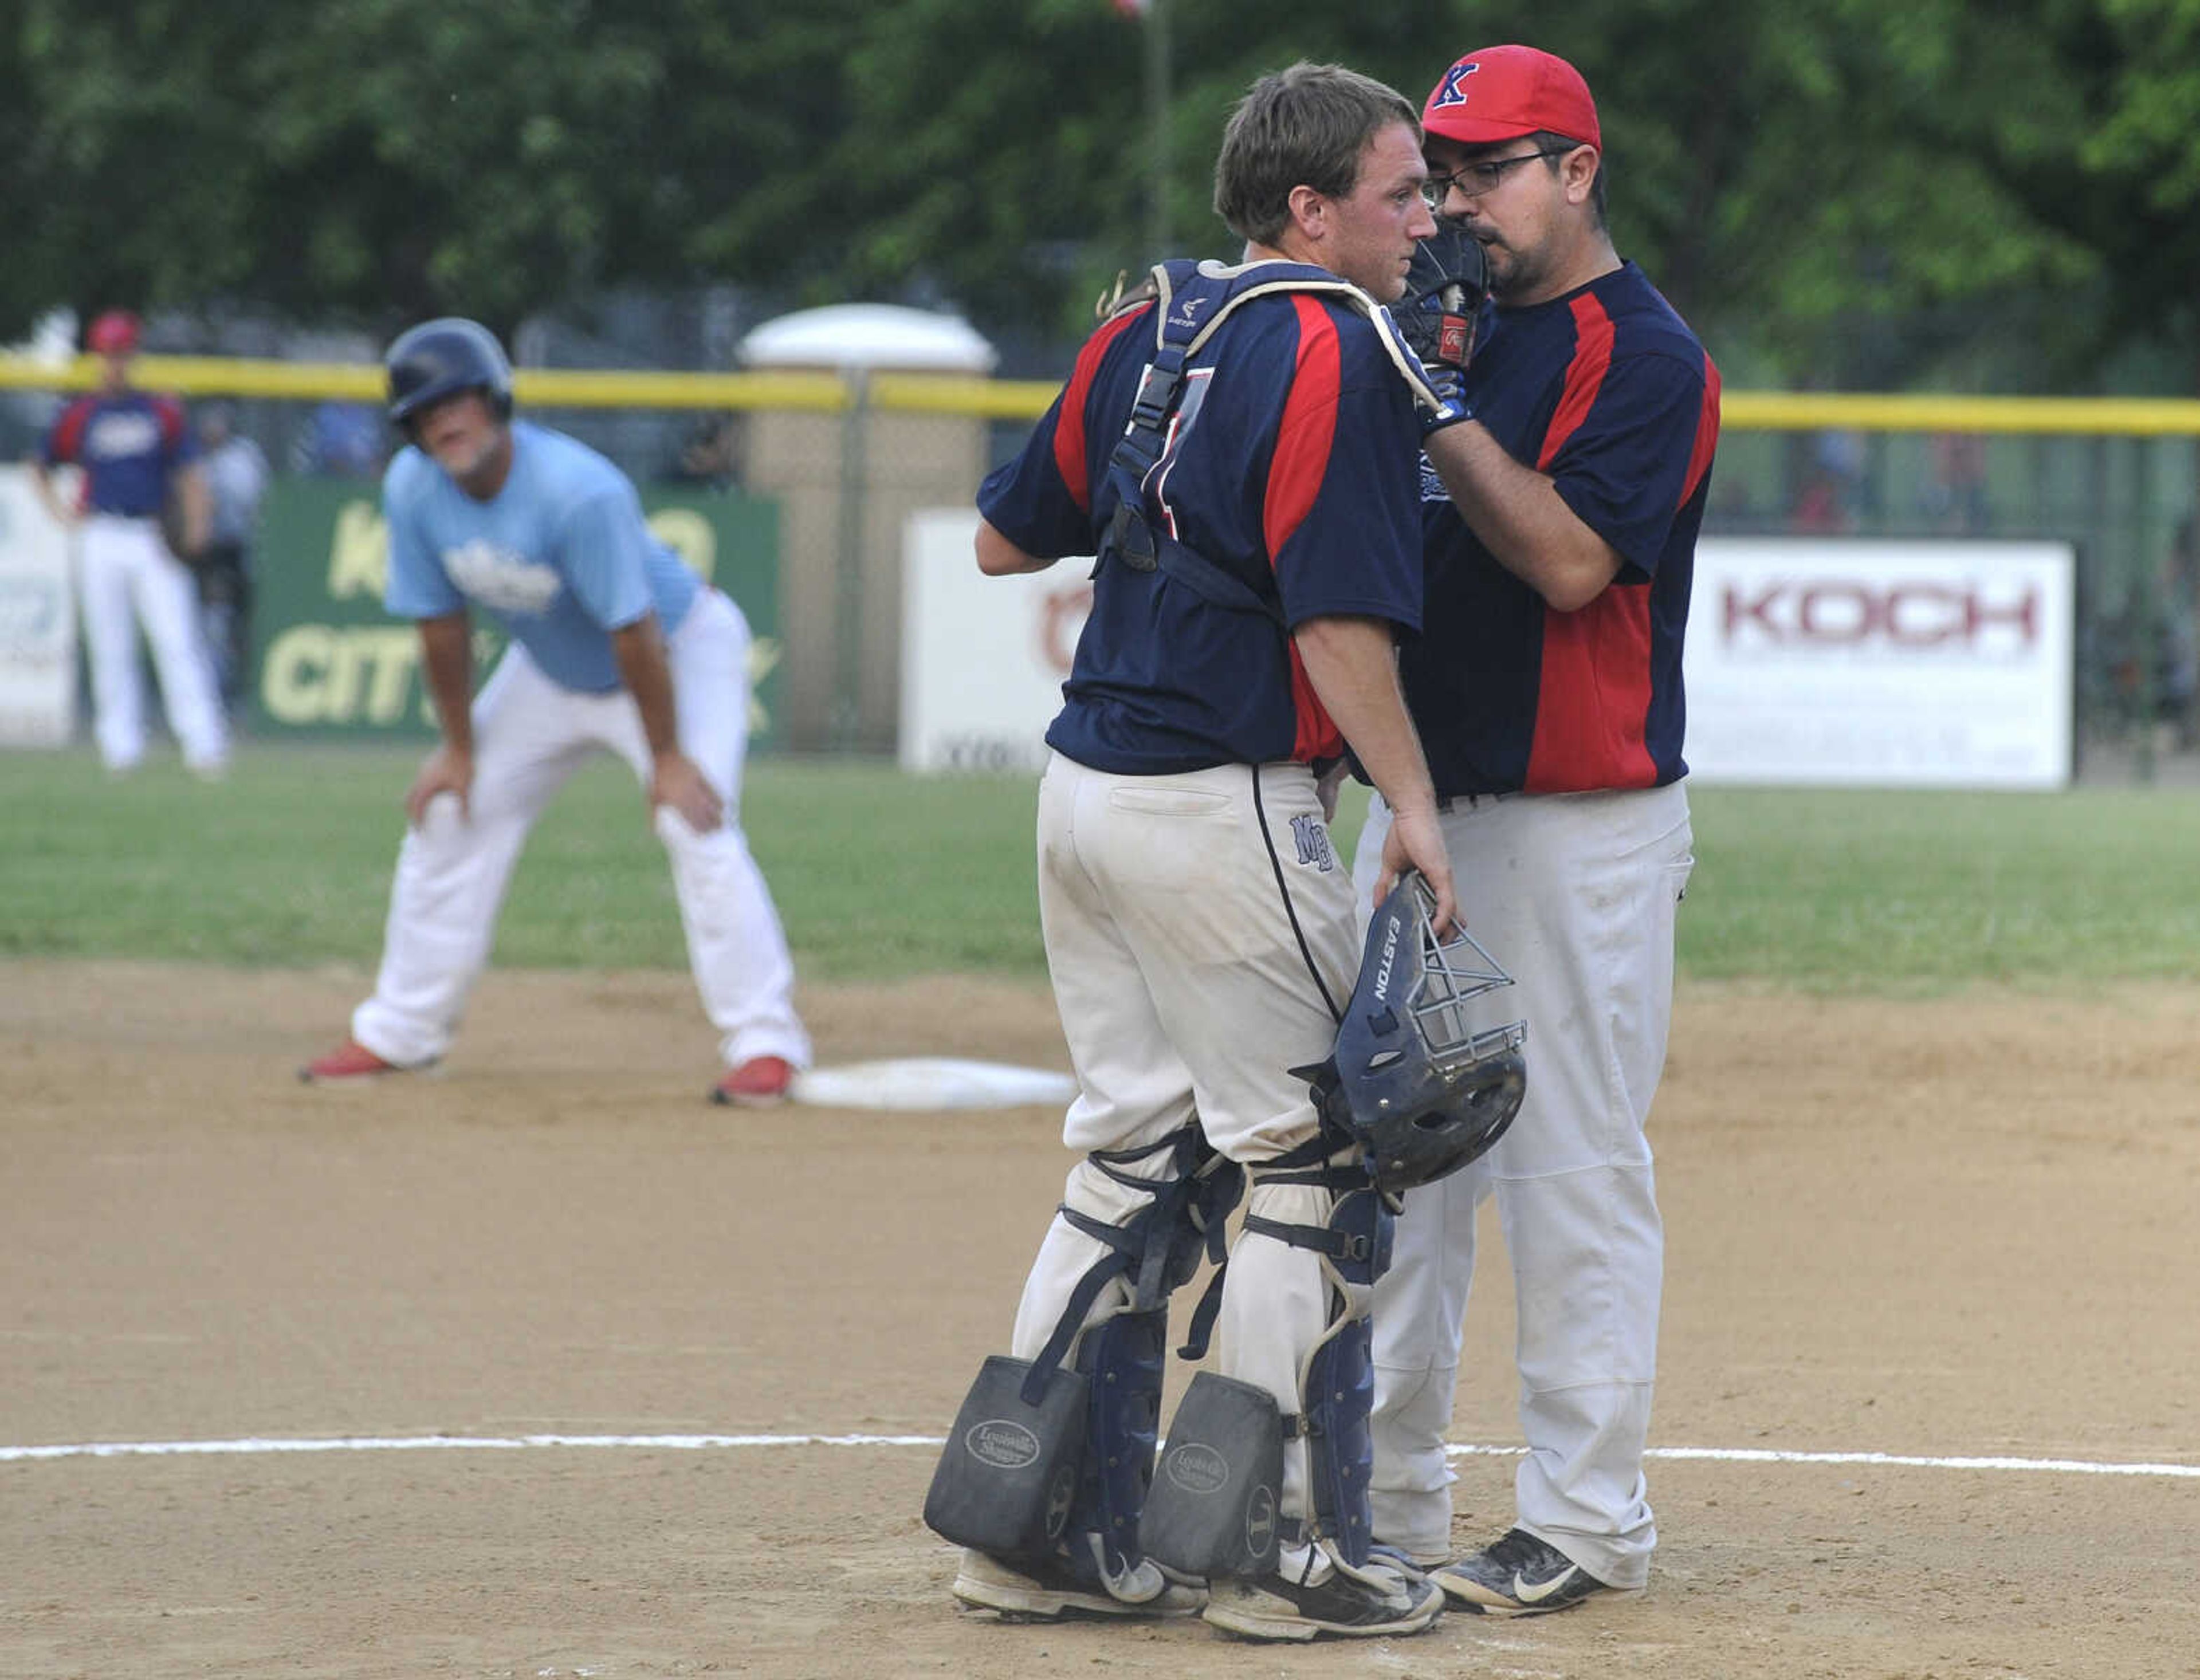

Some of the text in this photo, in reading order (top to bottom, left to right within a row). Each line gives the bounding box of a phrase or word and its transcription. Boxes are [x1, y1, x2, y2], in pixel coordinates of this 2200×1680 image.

[1433, 63, 1480, 110] K
[1720, 579, 2040, 651] KOCH
[1375, 915, 1401, 1001] EASTON
